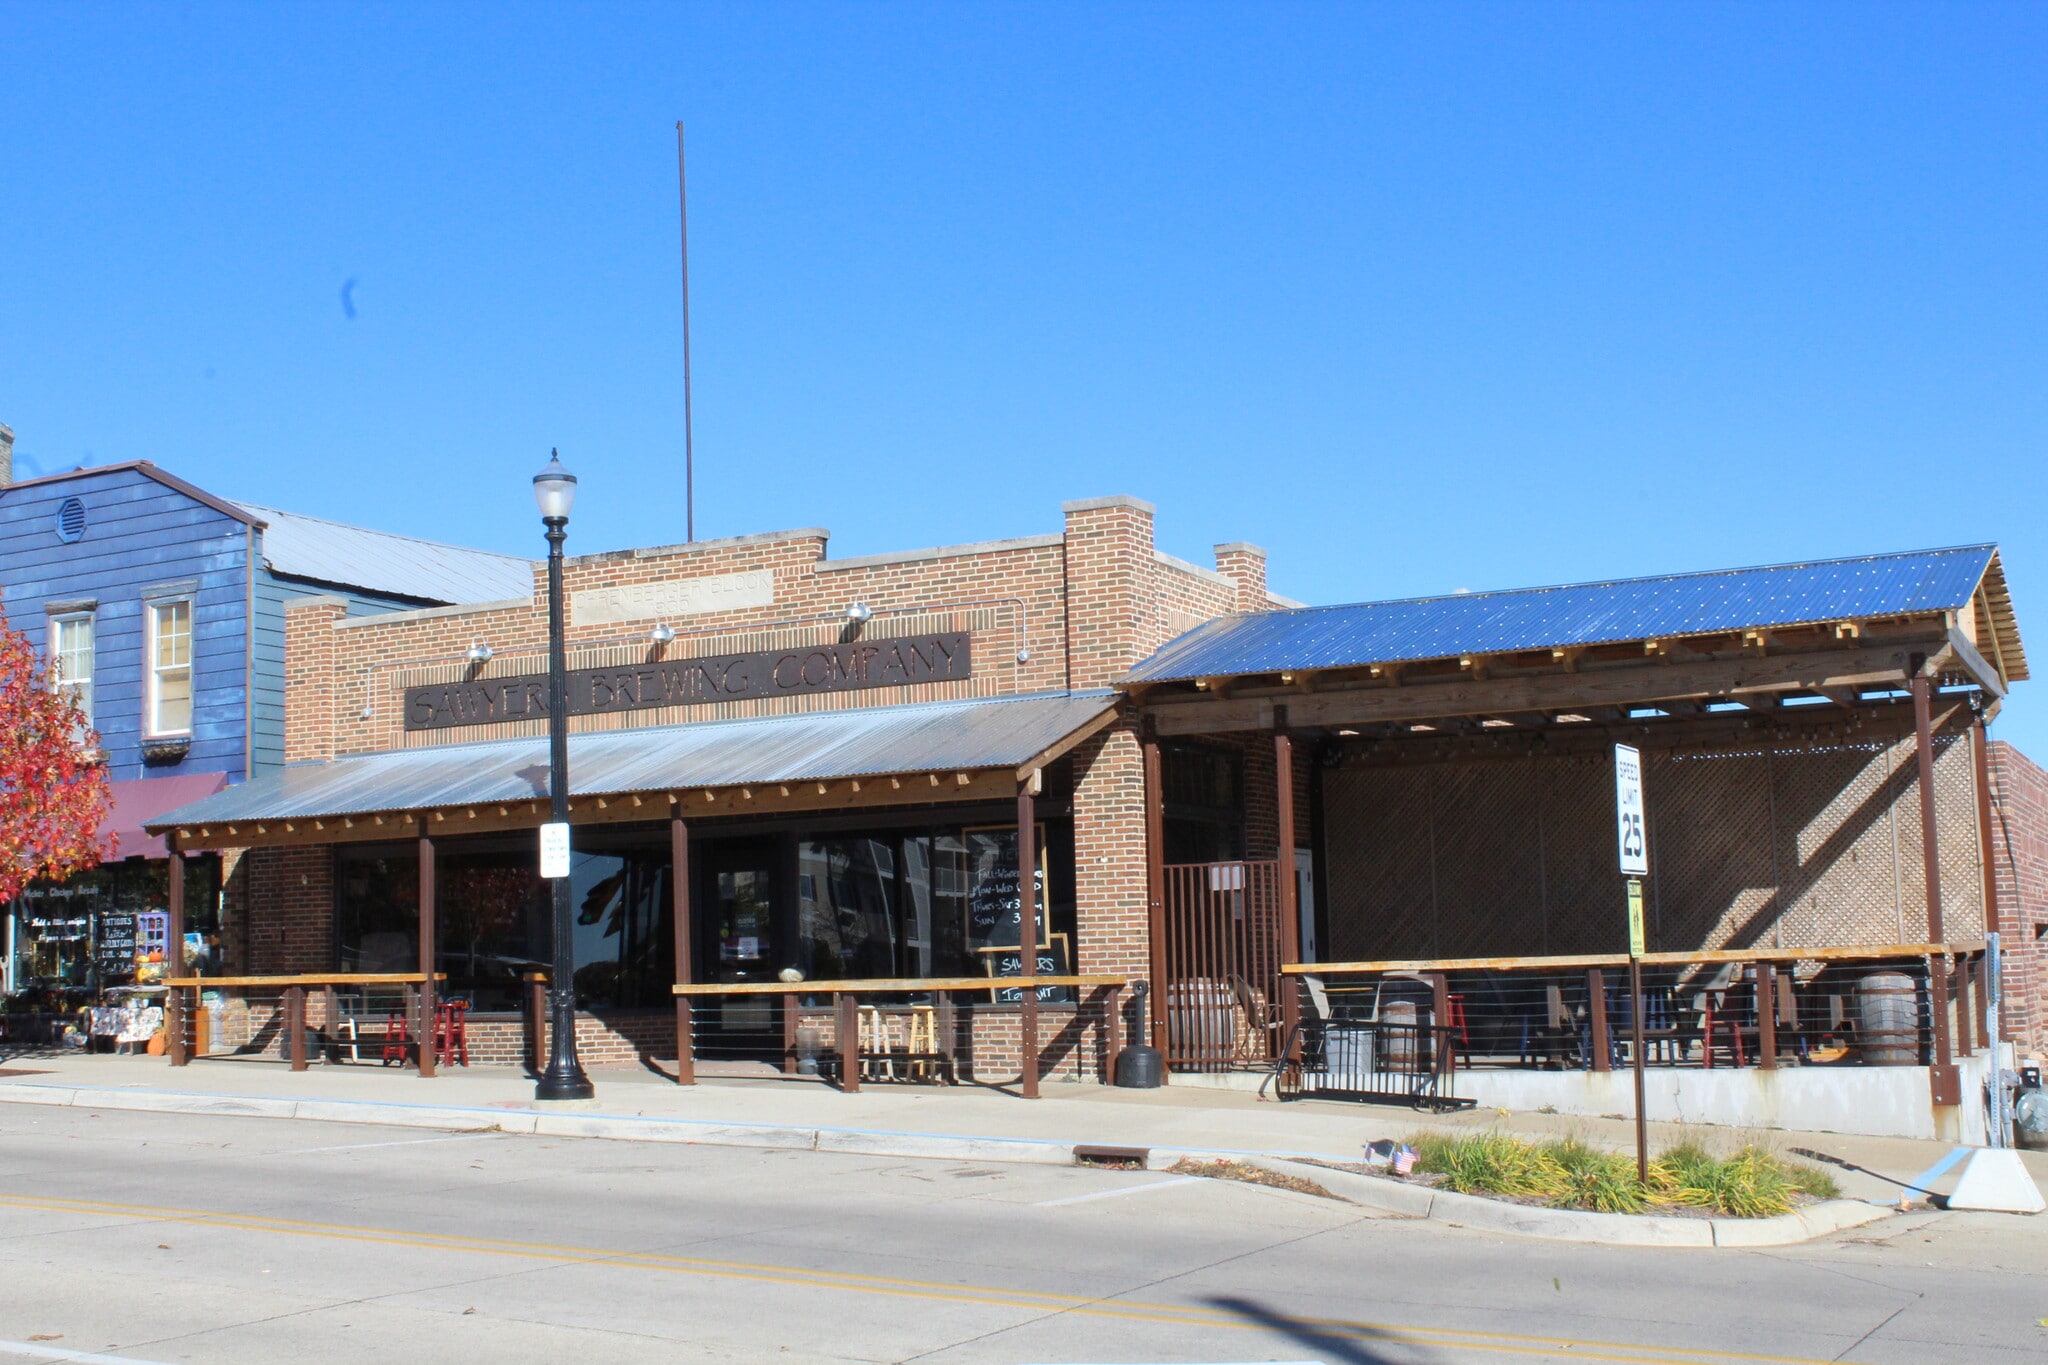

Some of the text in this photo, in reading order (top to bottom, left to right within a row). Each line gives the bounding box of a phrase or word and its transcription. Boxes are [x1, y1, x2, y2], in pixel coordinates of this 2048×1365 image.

[710, 571, 771, 594] BLOCK
[411, 638, 962, 724] SAWYER BREWING COMPANY
[1619, 761, 1639, 781] SPEED
[1621, 786, 1639, 806] LIMIT
[1622, 811, 1642, 857] 25
[975, 915, 995, 926] SUN
[1001, 957, 1054, 971] SAWRS
[1002, 986, 1056, 1000] TOHT
